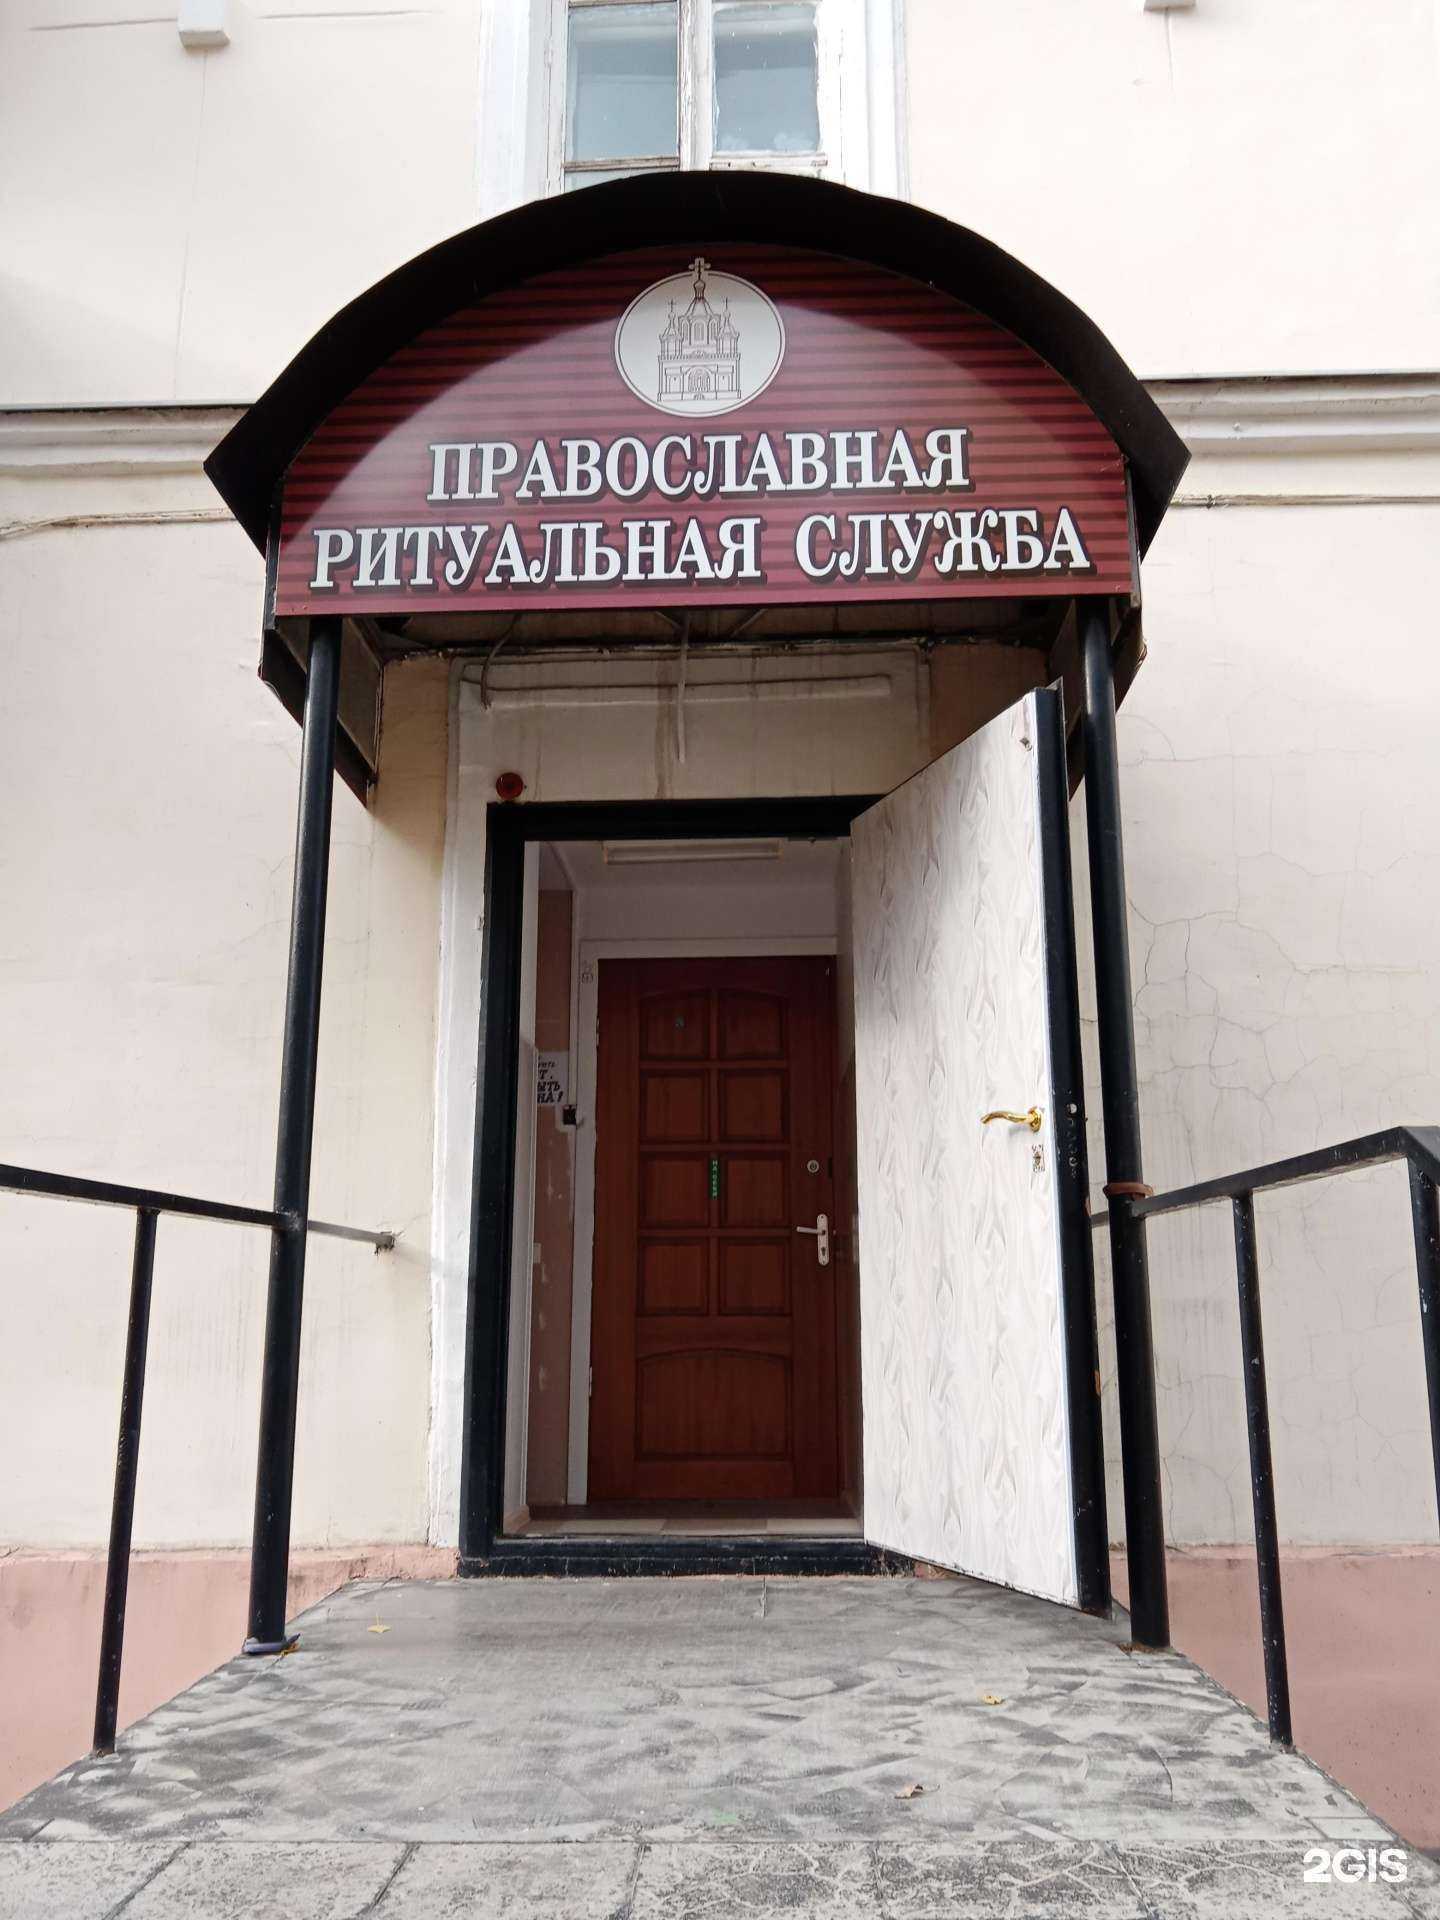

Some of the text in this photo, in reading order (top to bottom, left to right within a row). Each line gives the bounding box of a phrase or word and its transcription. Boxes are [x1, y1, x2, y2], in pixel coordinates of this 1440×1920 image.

[428, 428, 970, 503] ПРАВОСЛАВНАЯ
[309, 506, 1091, 590] РИТУАЛЬНАЯ СЛУЖБА
